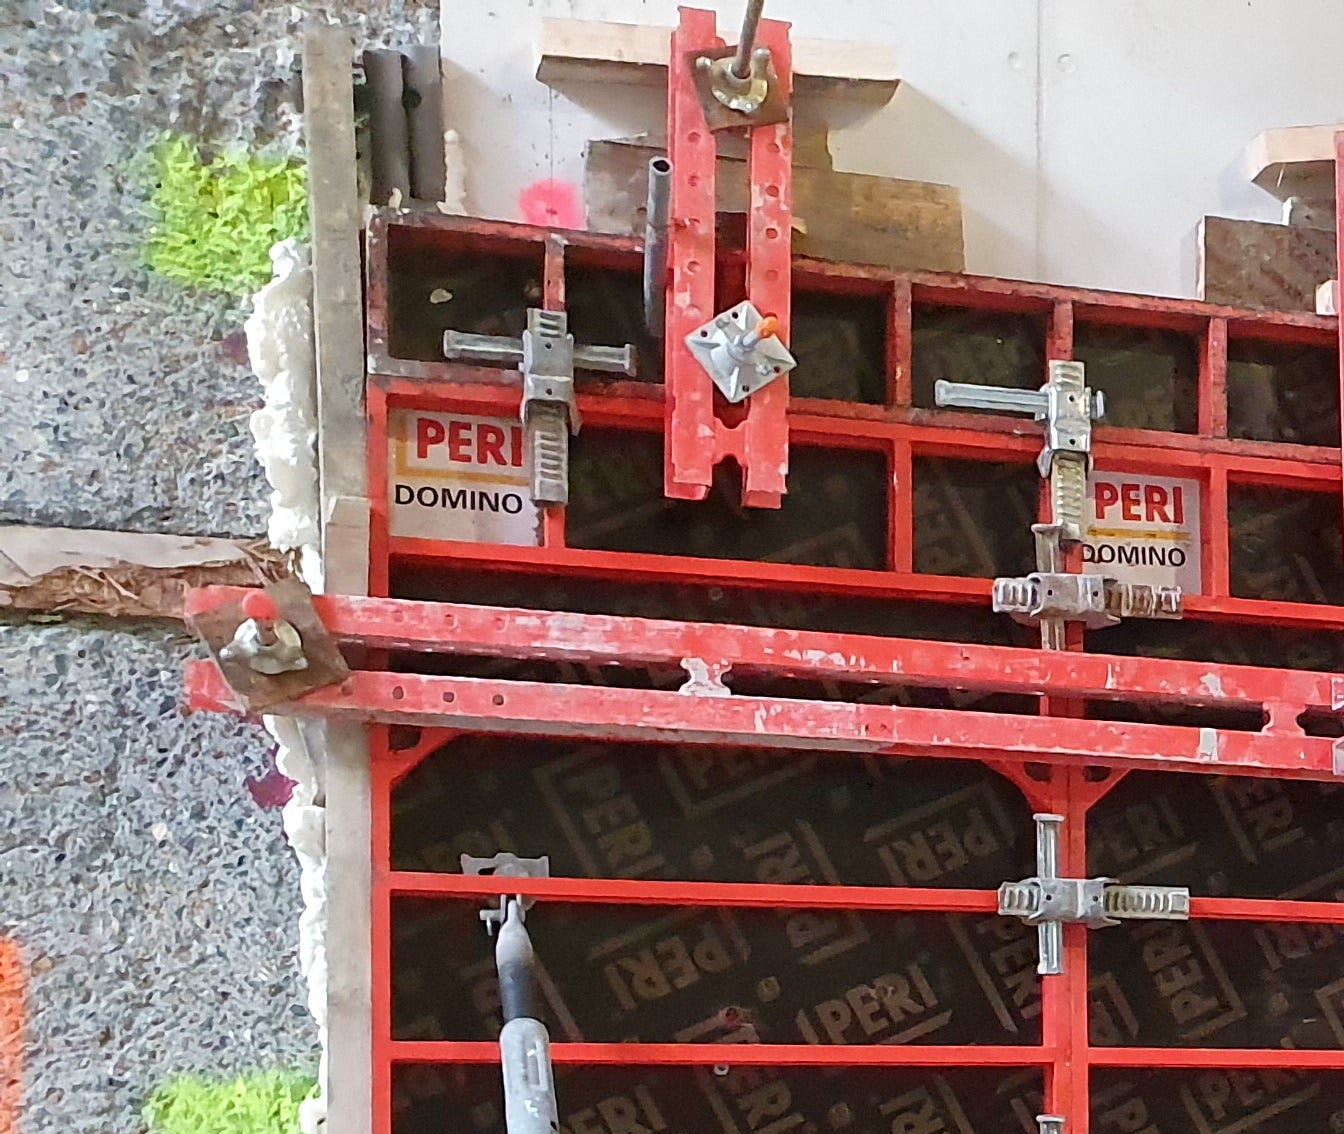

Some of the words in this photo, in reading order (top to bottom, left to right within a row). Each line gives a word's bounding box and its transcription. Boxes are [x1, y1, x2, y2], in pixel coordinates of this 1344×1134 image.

[417, 417, 523, 467] PERI
[395, 484, 523, 514] DOMINO
[1095, 482, 1184, 524] PERI
[1082, 543, 1186, 567] DOMINO
[876, 806, 999, 886] PERI
[604, 920, 732, 1011] PERI
[814, 962, 938, 1044] PERI
